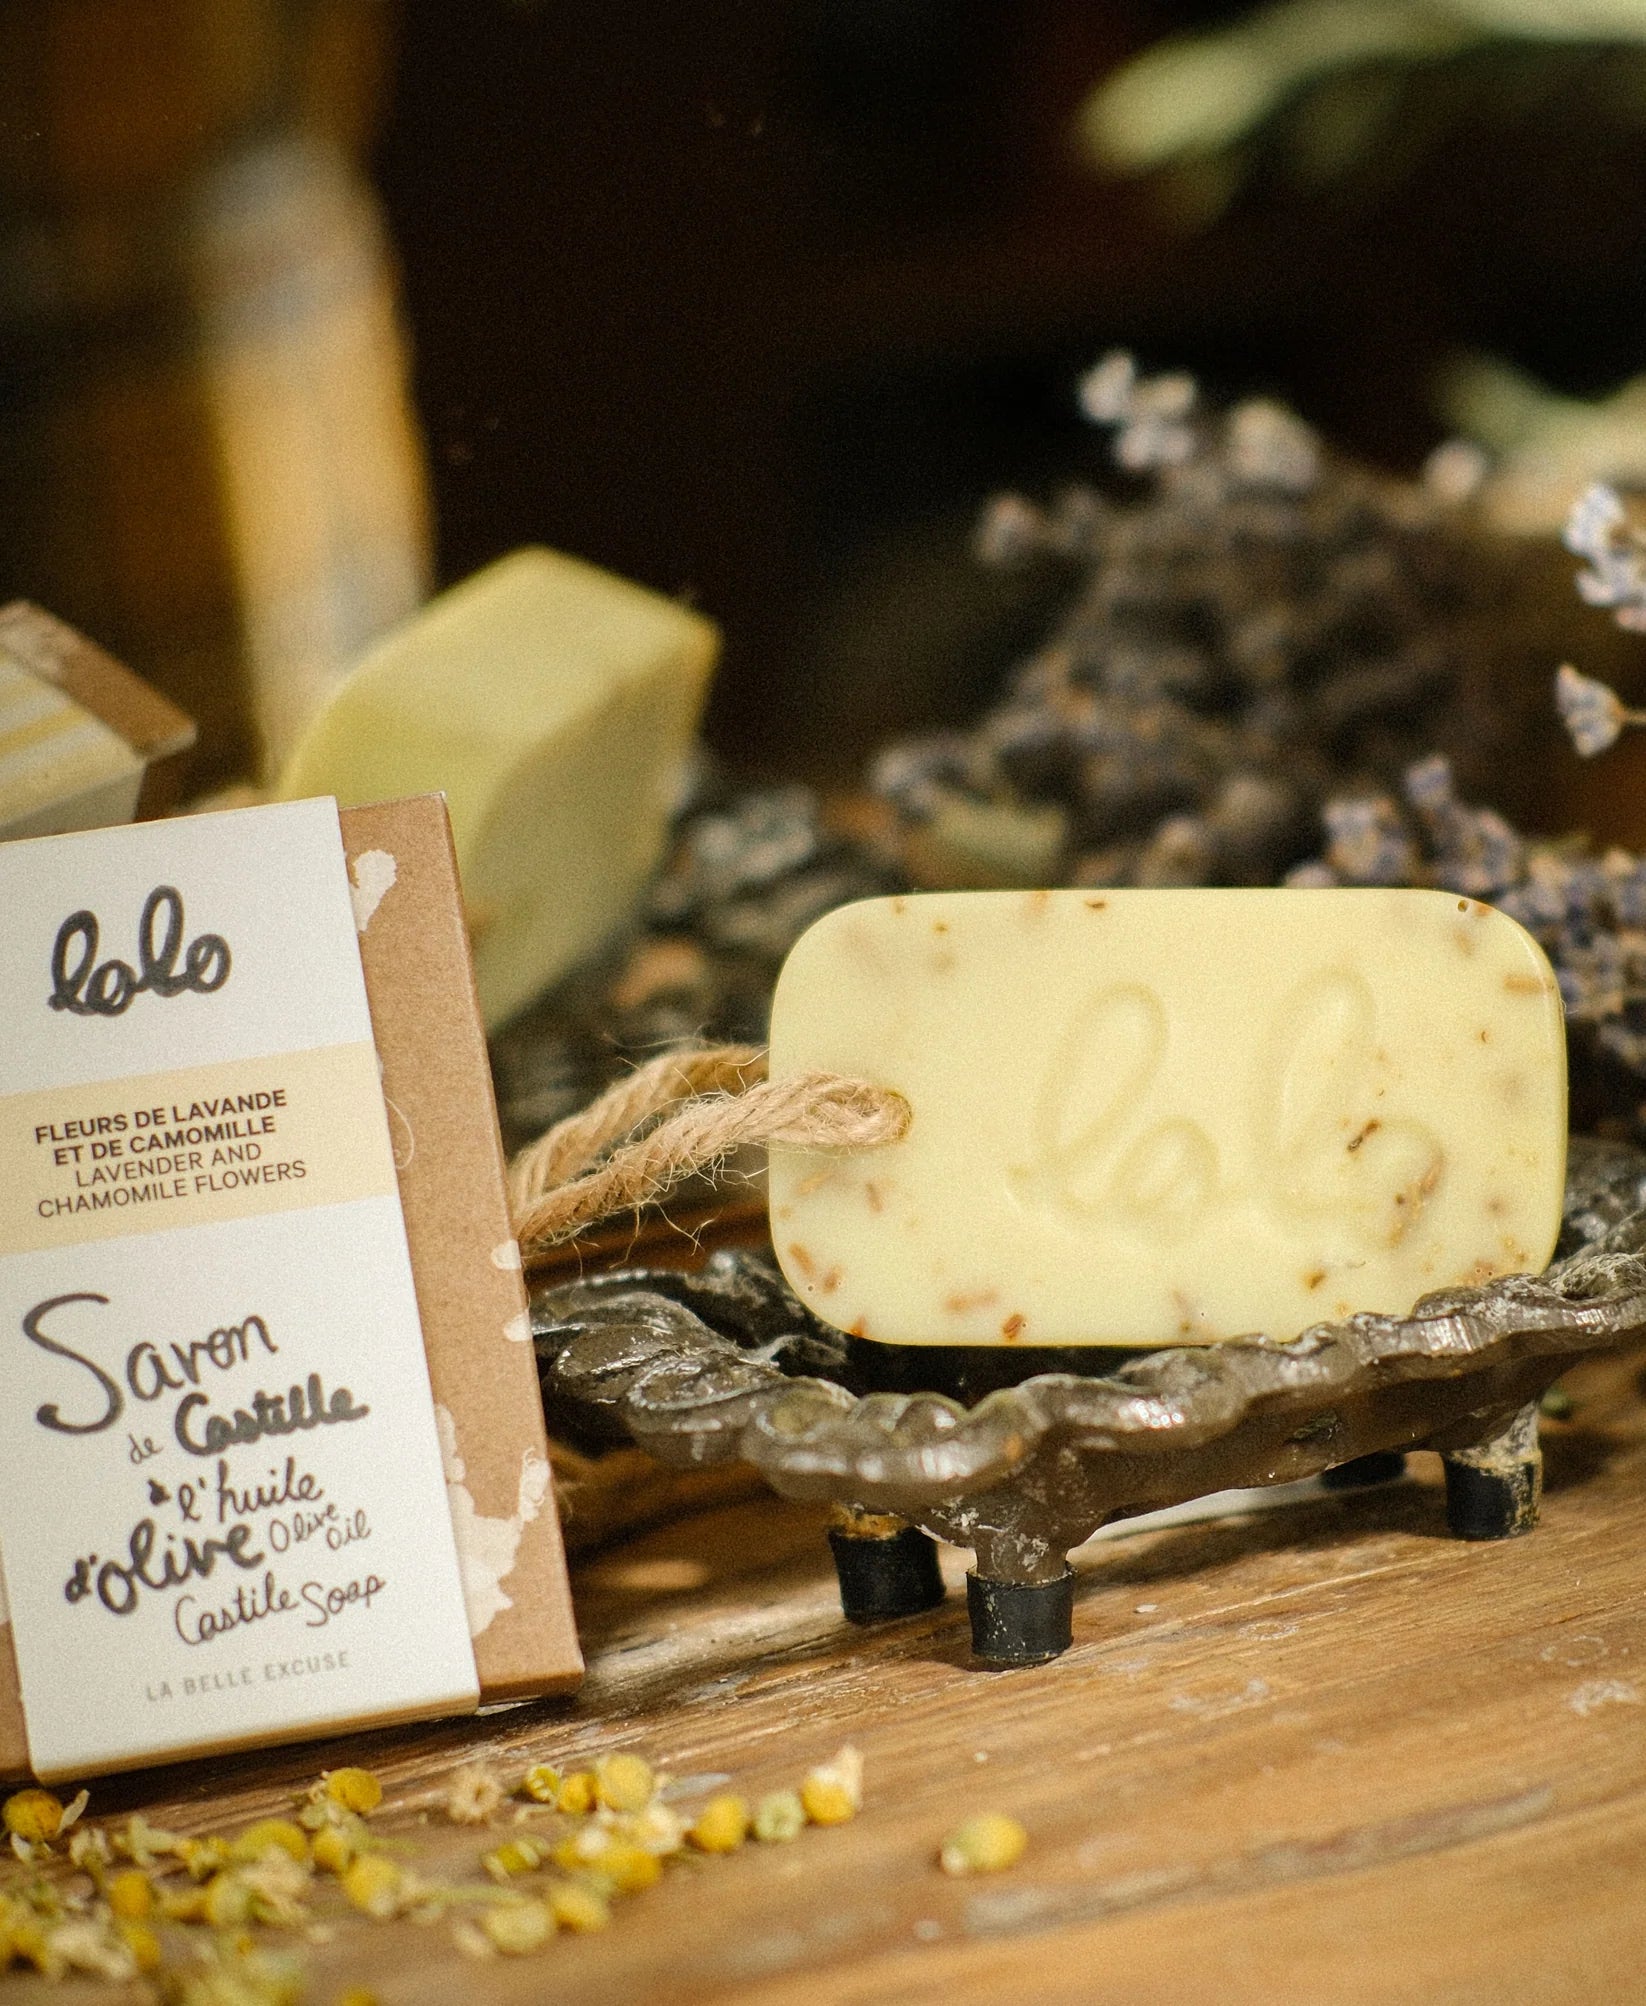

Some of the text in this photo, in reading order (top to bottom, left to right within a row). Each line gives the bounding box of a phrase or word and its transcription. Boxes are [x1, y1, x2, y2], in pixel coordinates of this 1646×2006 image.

[47, 885, 232, 1017] lolo
[35, 1089, 288, 1145] FLEURS DE LAVANDE
[53, 1115, 276, 1166] ET DE CAMOMILLE
[38, 1160, 307, 1218] CHAMOMILE FLOWERS
[75, 1142, 262, 1188] LAVENDER AND
[23, 1292, 279, 1434] Savon
[129, 1373, 370, 1464] de Castille
[178, 1456, 323, 1522] l'huile
[269, 1504, 372, 1553] Olive Oil
[175, 1571, 386, 1645] Castile Soap
[146, 1650, 352, 1702] LA BELLE EXCUSE
